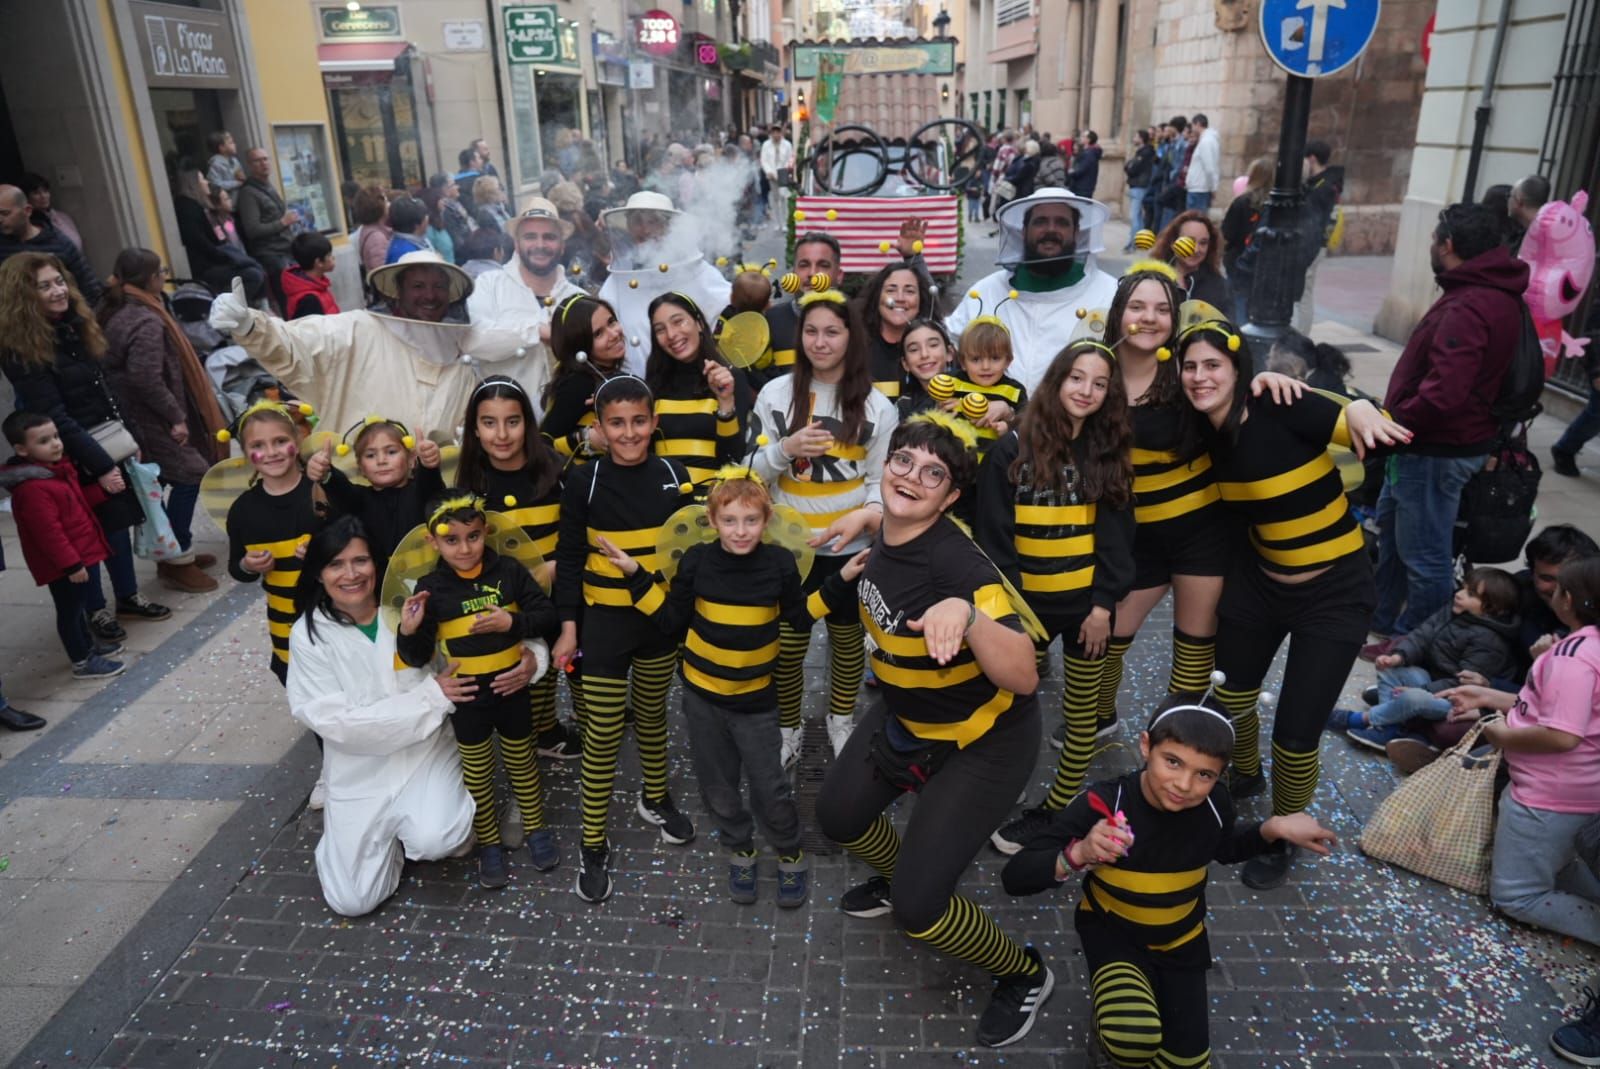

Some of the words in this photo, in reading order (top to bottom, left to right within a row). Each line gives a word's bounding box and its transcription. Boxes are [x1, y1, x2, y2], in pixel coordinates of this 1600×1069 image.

[177, 23, 213, 51] Fincas
[641, 18, 675, 31] TODO
[173, 47, 191, 73] La
[191, 49, 228, 74] Plana
